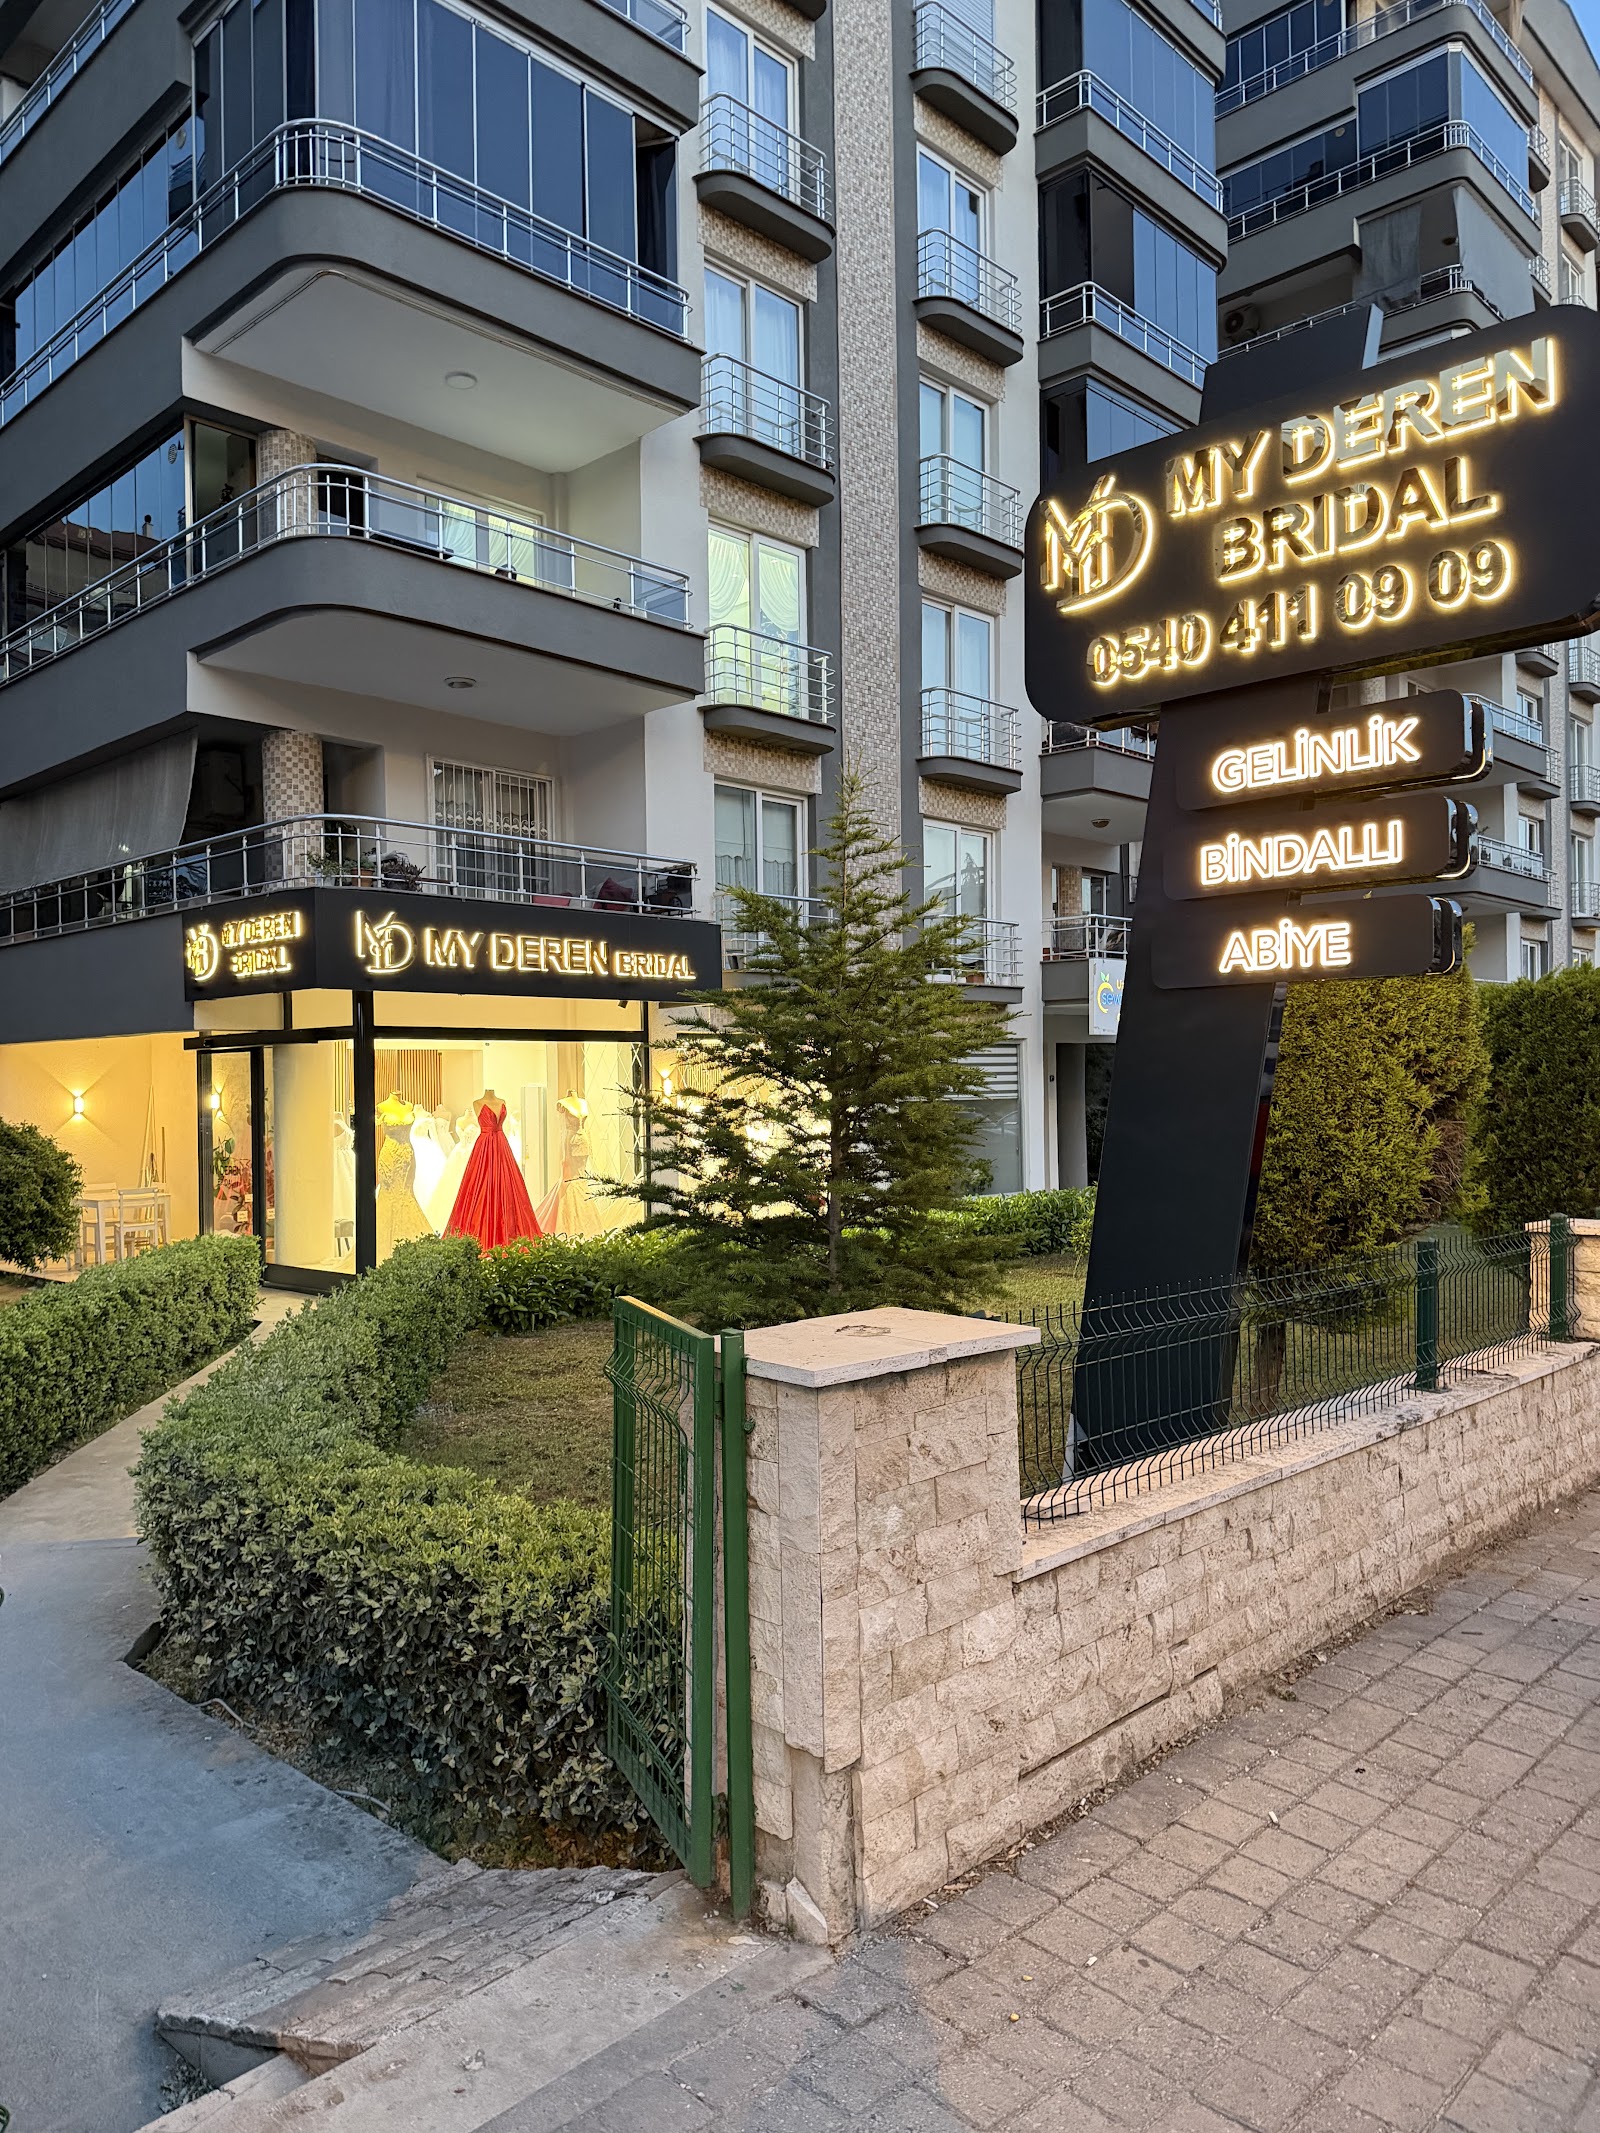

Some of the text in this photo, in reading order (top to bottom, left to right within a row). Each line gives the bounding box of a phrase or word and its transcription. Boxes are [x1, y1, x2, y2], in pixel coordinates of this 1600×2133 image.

[1166, 336, 1558, 518] MY DEREN
[1214, 456, 1498, 584] BRIDAL
[1087, 540, 1512, 687] 0540 411 09 09
[1211, 714, 1421, 793] GELİNLİK
[1200, 820, 1403, 886] BİNDALLI
[425, 927, 697, 980] MY DEREN BRIDAL
[1218, 918, 1351, 973] ABİYE
